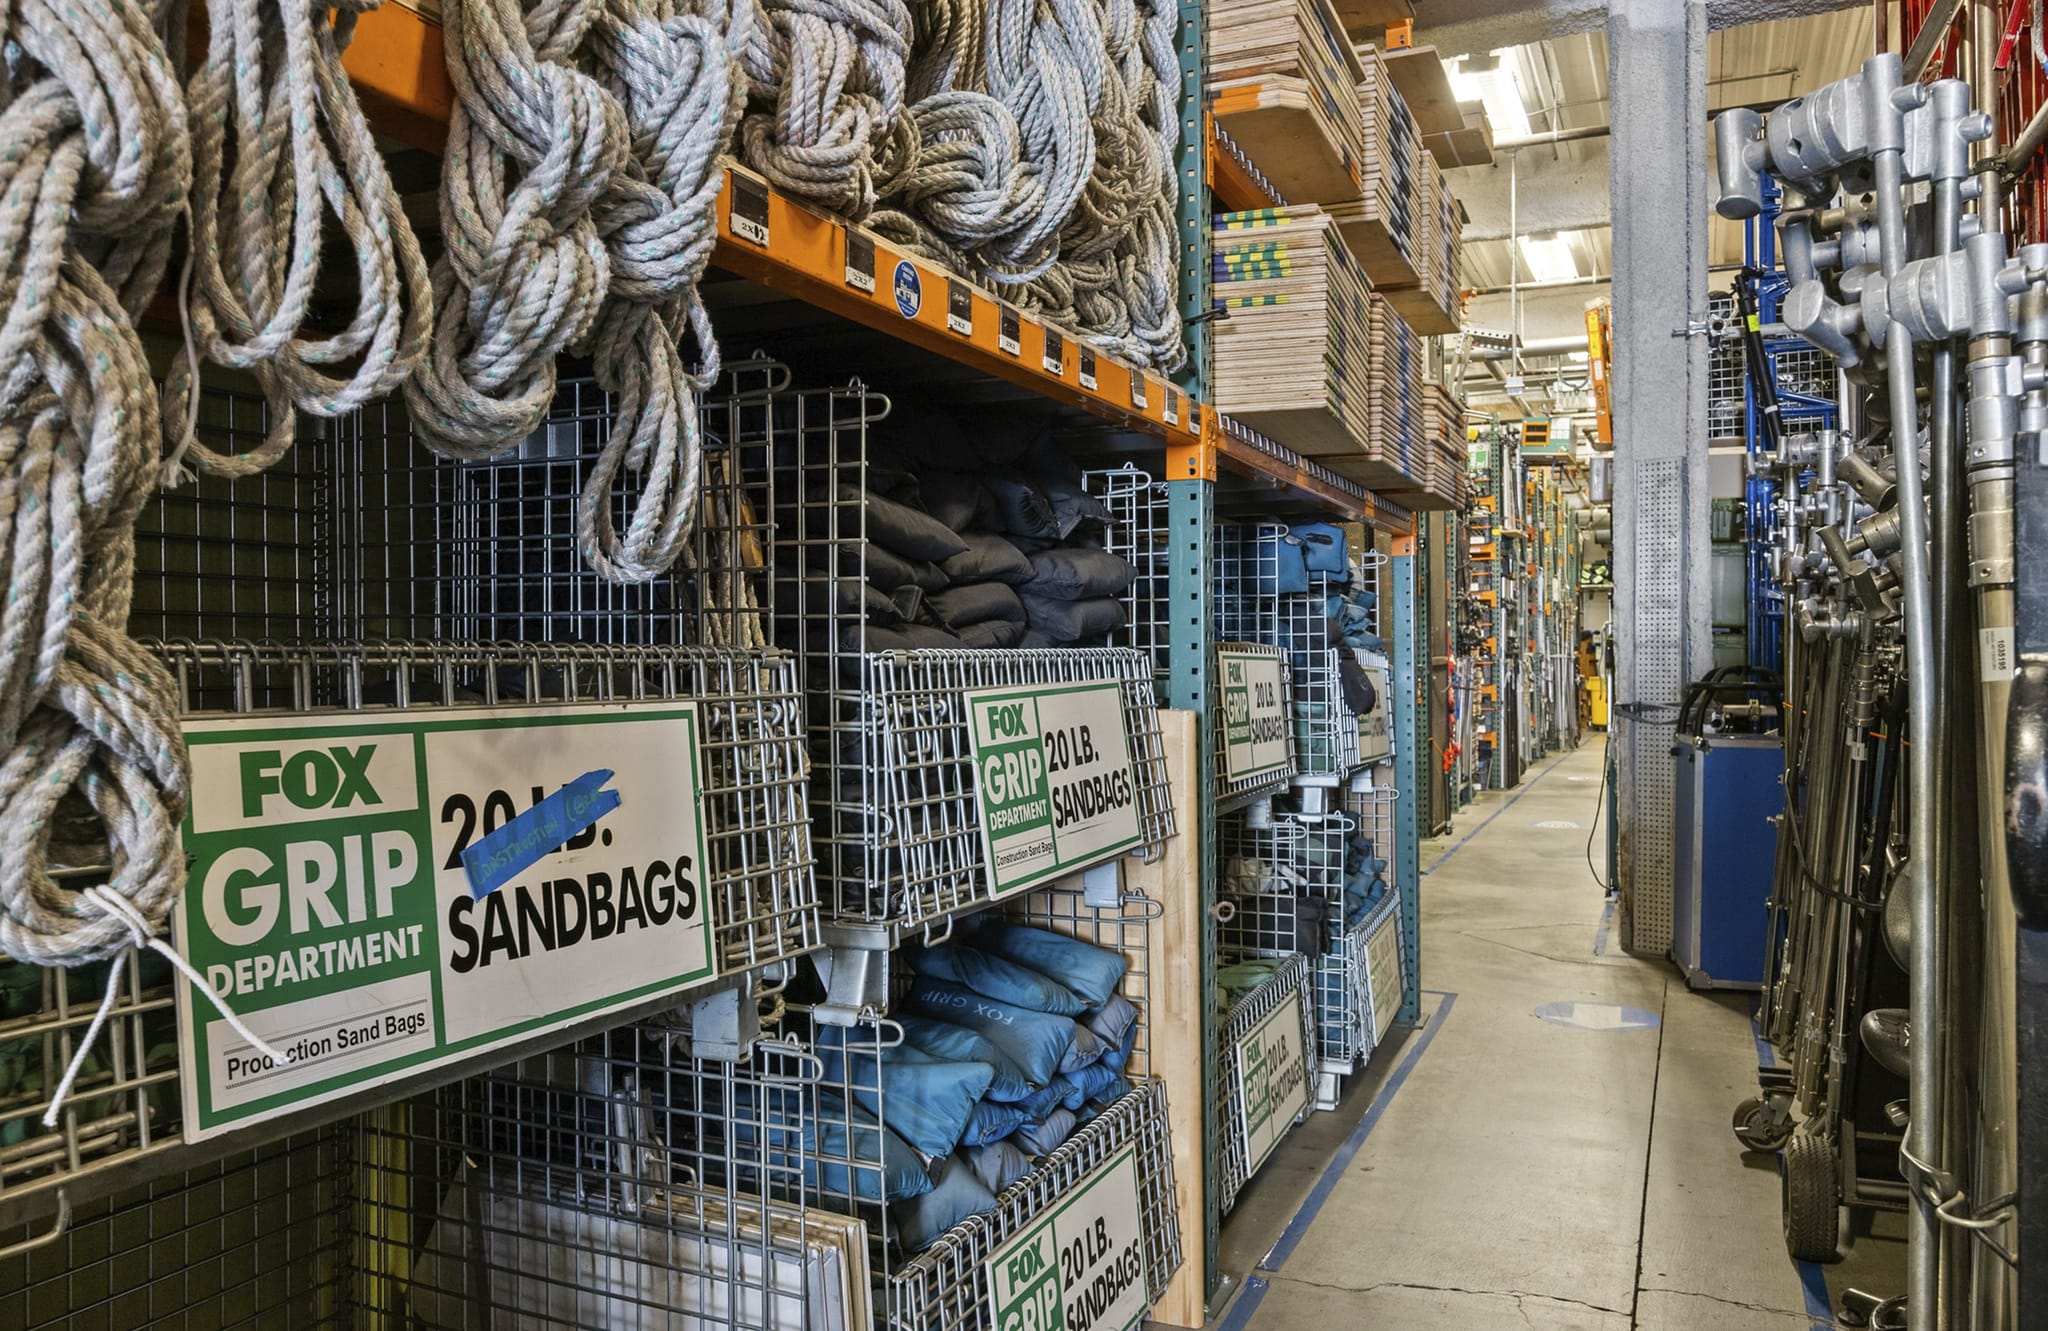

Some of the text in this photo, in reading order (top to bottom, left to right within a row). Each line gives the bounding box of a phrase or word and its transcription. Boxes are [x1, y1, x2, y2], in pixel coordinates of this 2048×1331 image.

[1228, 662, 1242, 683] FOX
[1255, 682, 1276, 708] 20 LB.
[987, 703, 1028, 740] FOX
[1227, 692, 1248, 724] GRIP
[1044, 725, 1099, 773] 20 LB.
[239, 744, 384, 818] FOX
[984, 748, 1042, 805] GRIP
[1052, 768, 1131, 829] SANDBAGS
[989, 799, 1047, 831] DEPARTMENT
[996, 847, 1028, 866] Construction
[1029, 844, 1041, 856] Sand
[202, 830, 418, 946] GRIP
[448, 855, 697, 974] SANDBAGS
[207, 924, 423, 1000] DEPARTMENT
[921, 990, 1014, 1025] FOX GRIP
[227, 1012, 425, 1080] Prodction Sand Bags
[1246, 1037, 1262, 1070] FOX
[1268, 1034, 1289, 1077] 20 LB.
[1245, 1065, 1267, 1114] GRIP
[1271, 1055, 1303, 1114] SHOTBAGS
[1007, 1235, 1046, 1297] FOX
[1062, 1216, 1112, 1293] 20 LB.
[1066, 1238, 1141, 1331] SANDBAGS
